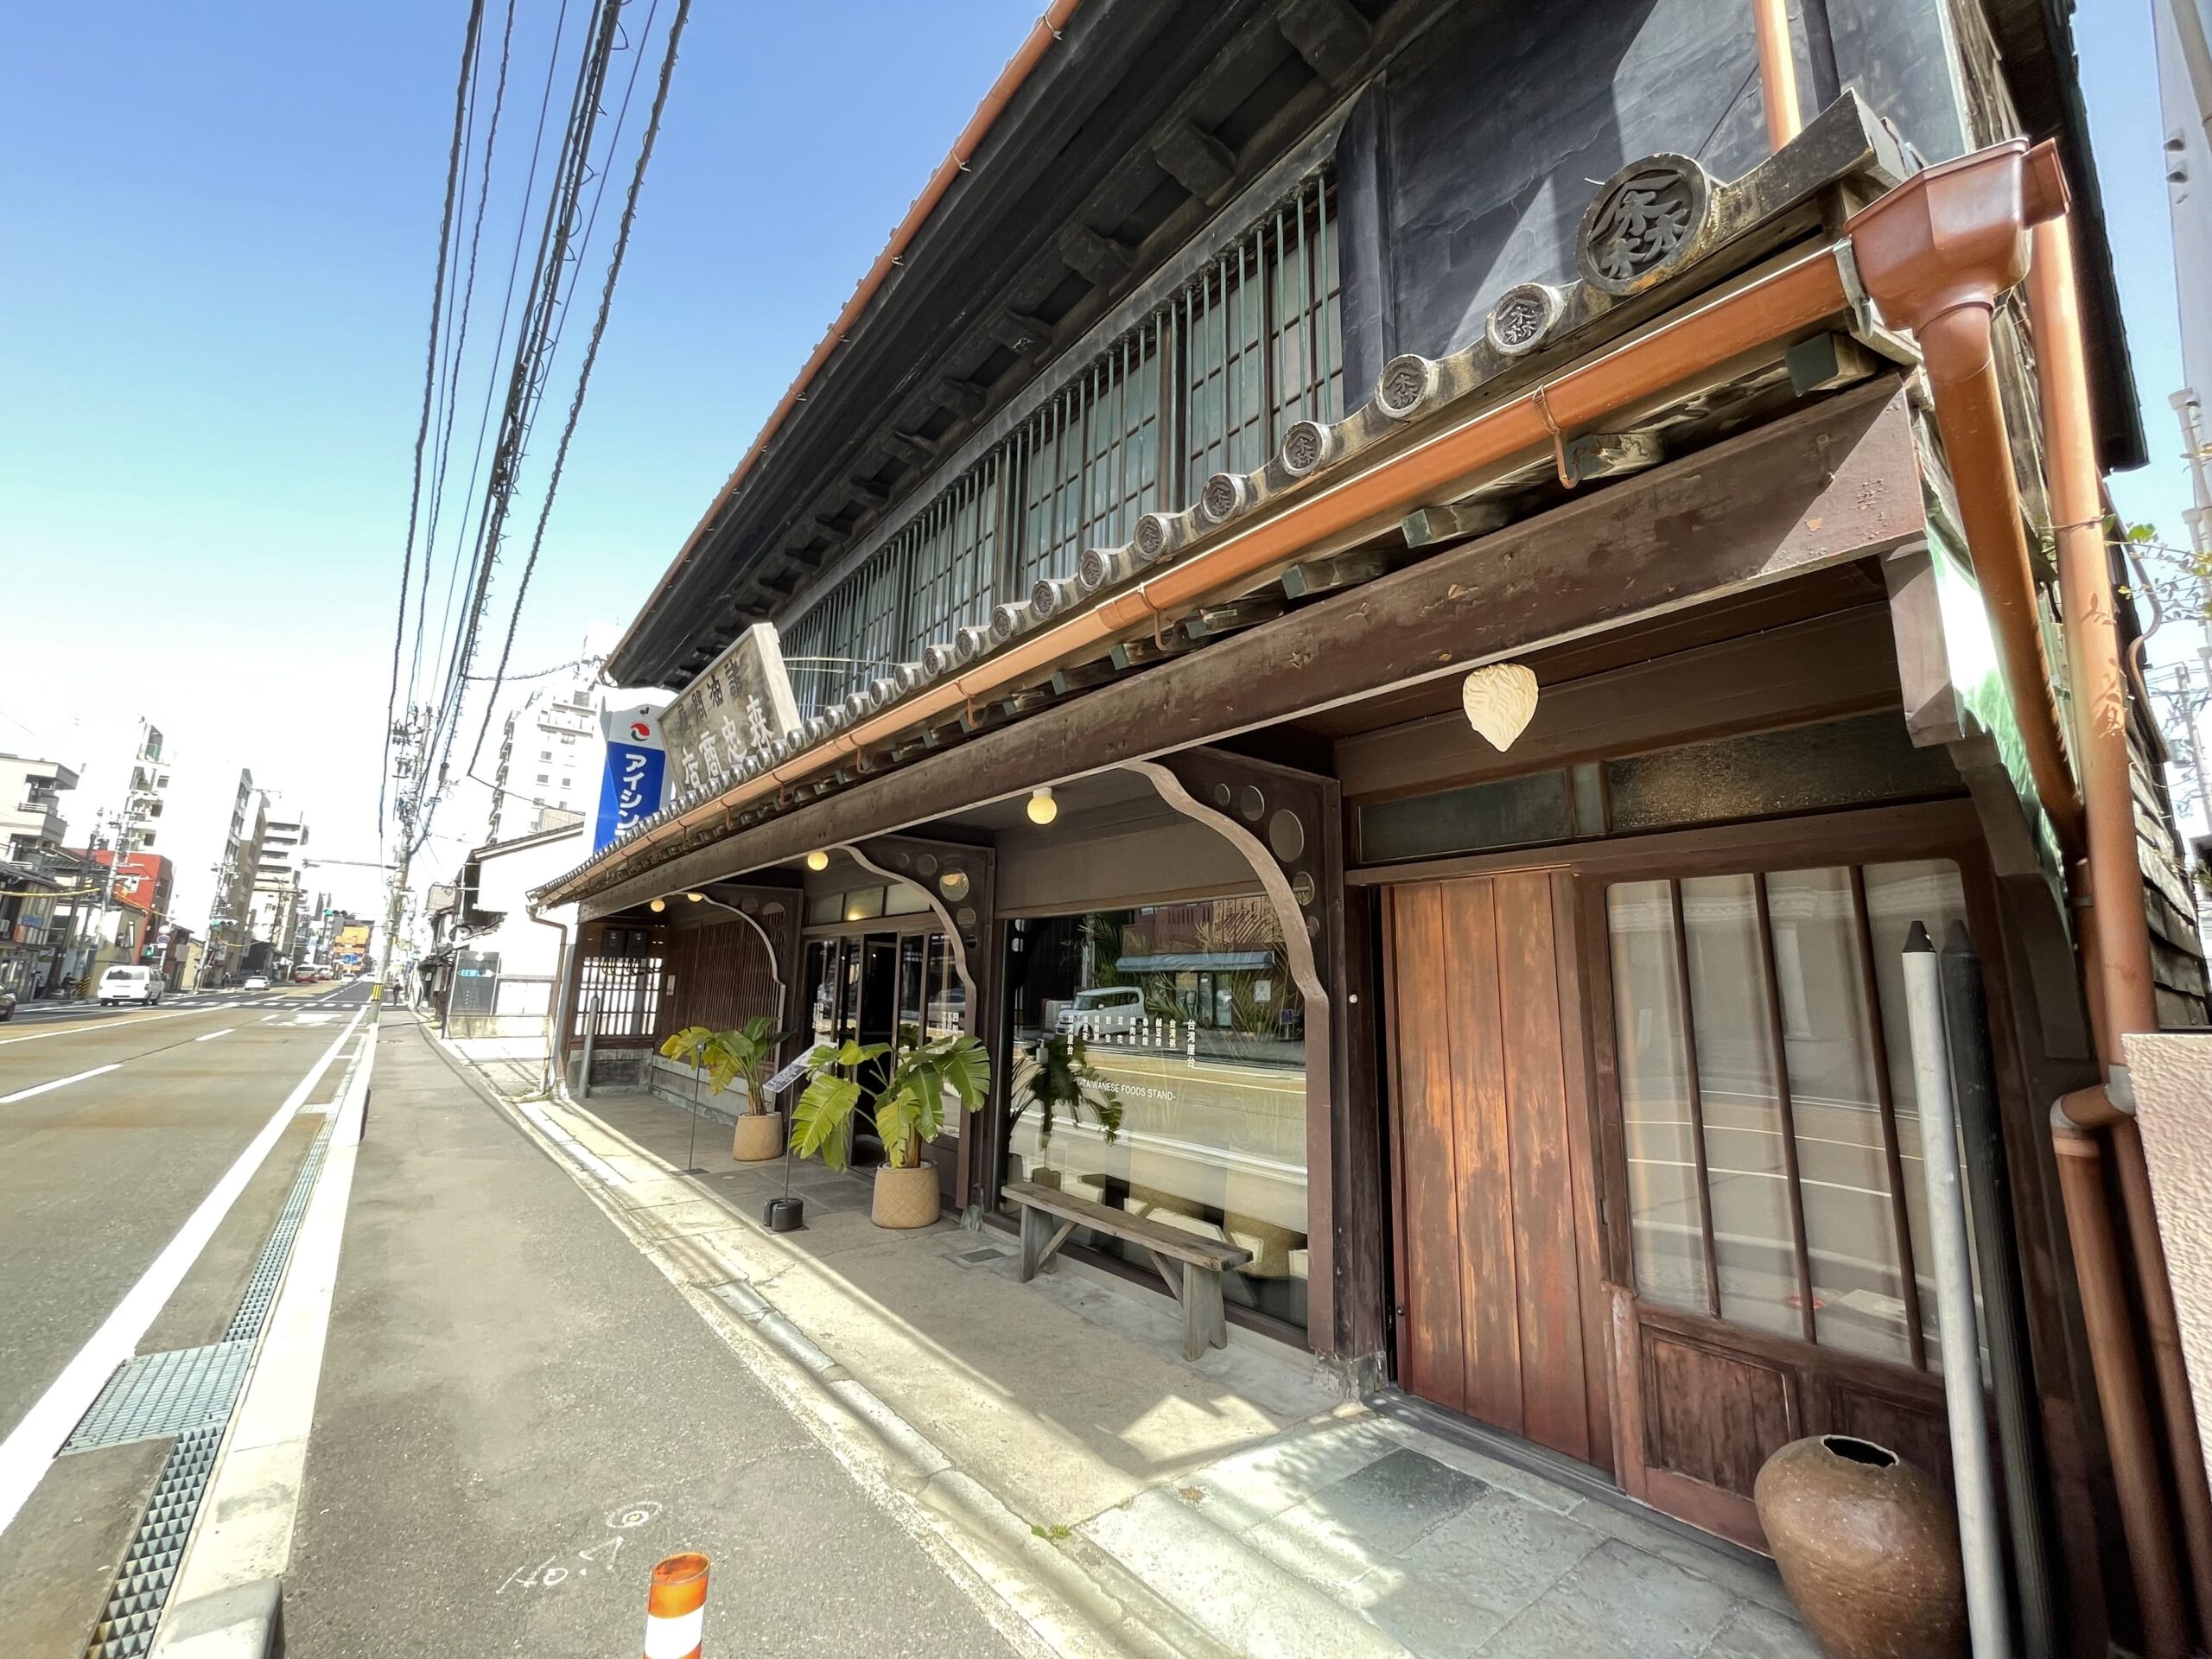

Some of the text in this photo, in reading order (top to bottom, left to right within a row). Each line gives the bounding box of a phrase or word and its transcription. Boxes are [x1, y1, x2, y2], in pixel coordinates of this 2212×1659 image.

[614, 753, 647, 836] アイシン
[1186, 1018, 1196, 1068] 台湾屋台
[1121, 1084, 1146, 1096] FOODS
[1147, 1088, 1176, 1101] STAND-
